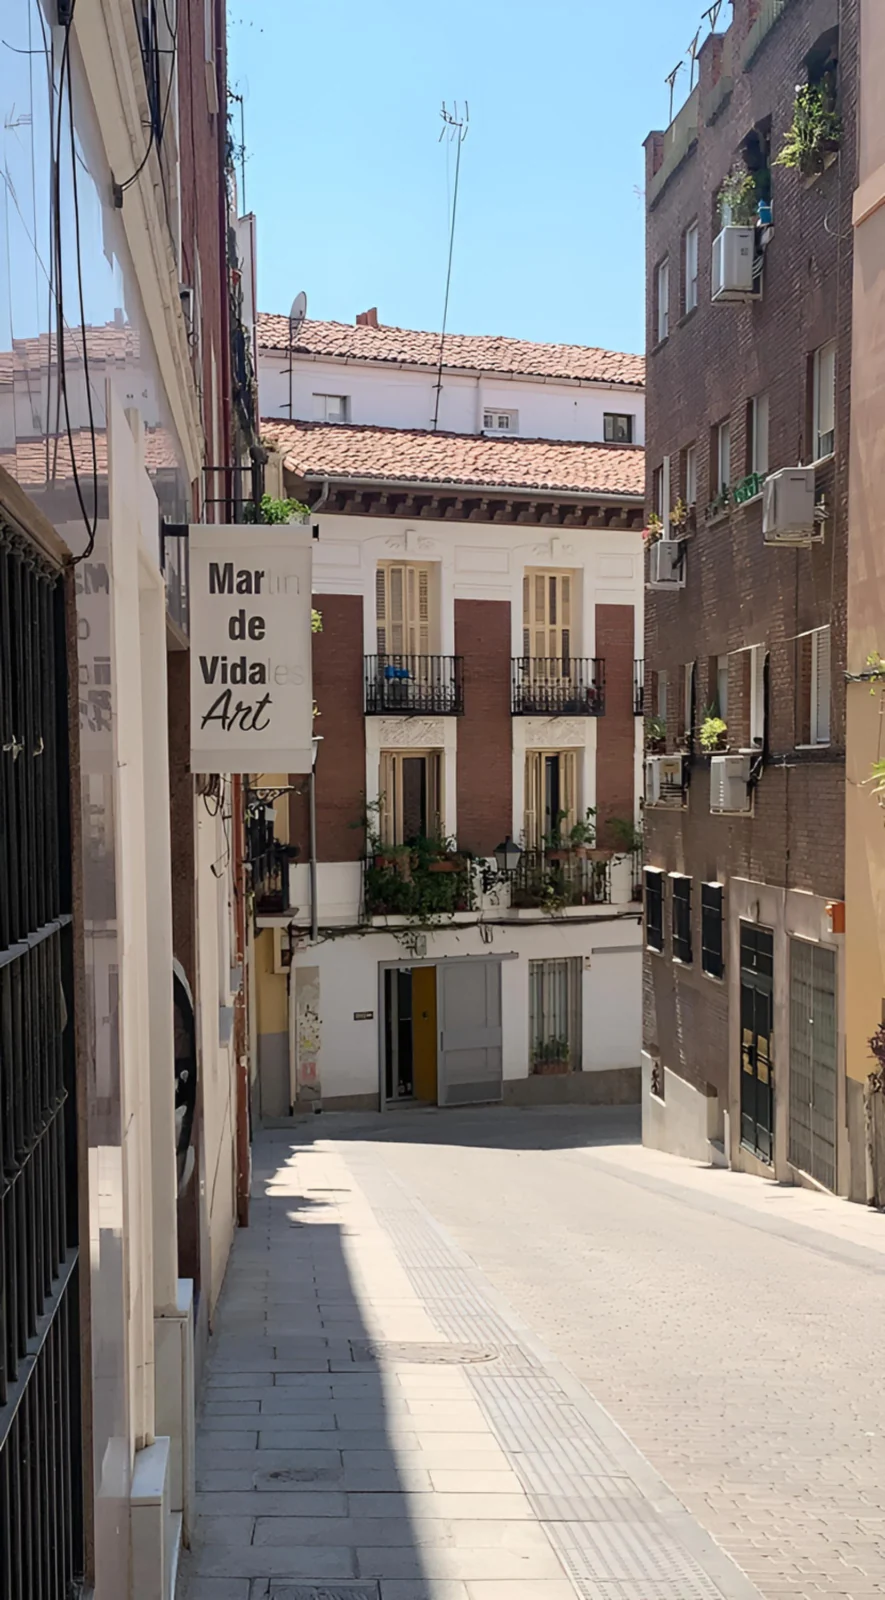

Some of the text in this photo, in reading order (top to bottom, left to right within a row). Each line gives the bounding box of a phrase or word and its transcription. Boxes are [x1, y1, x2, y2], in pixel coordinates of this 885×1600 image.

[228, 609, 265, 640] de
[199, 655, 304, 685] Vidales
[200, 688, 273, 731] Art
